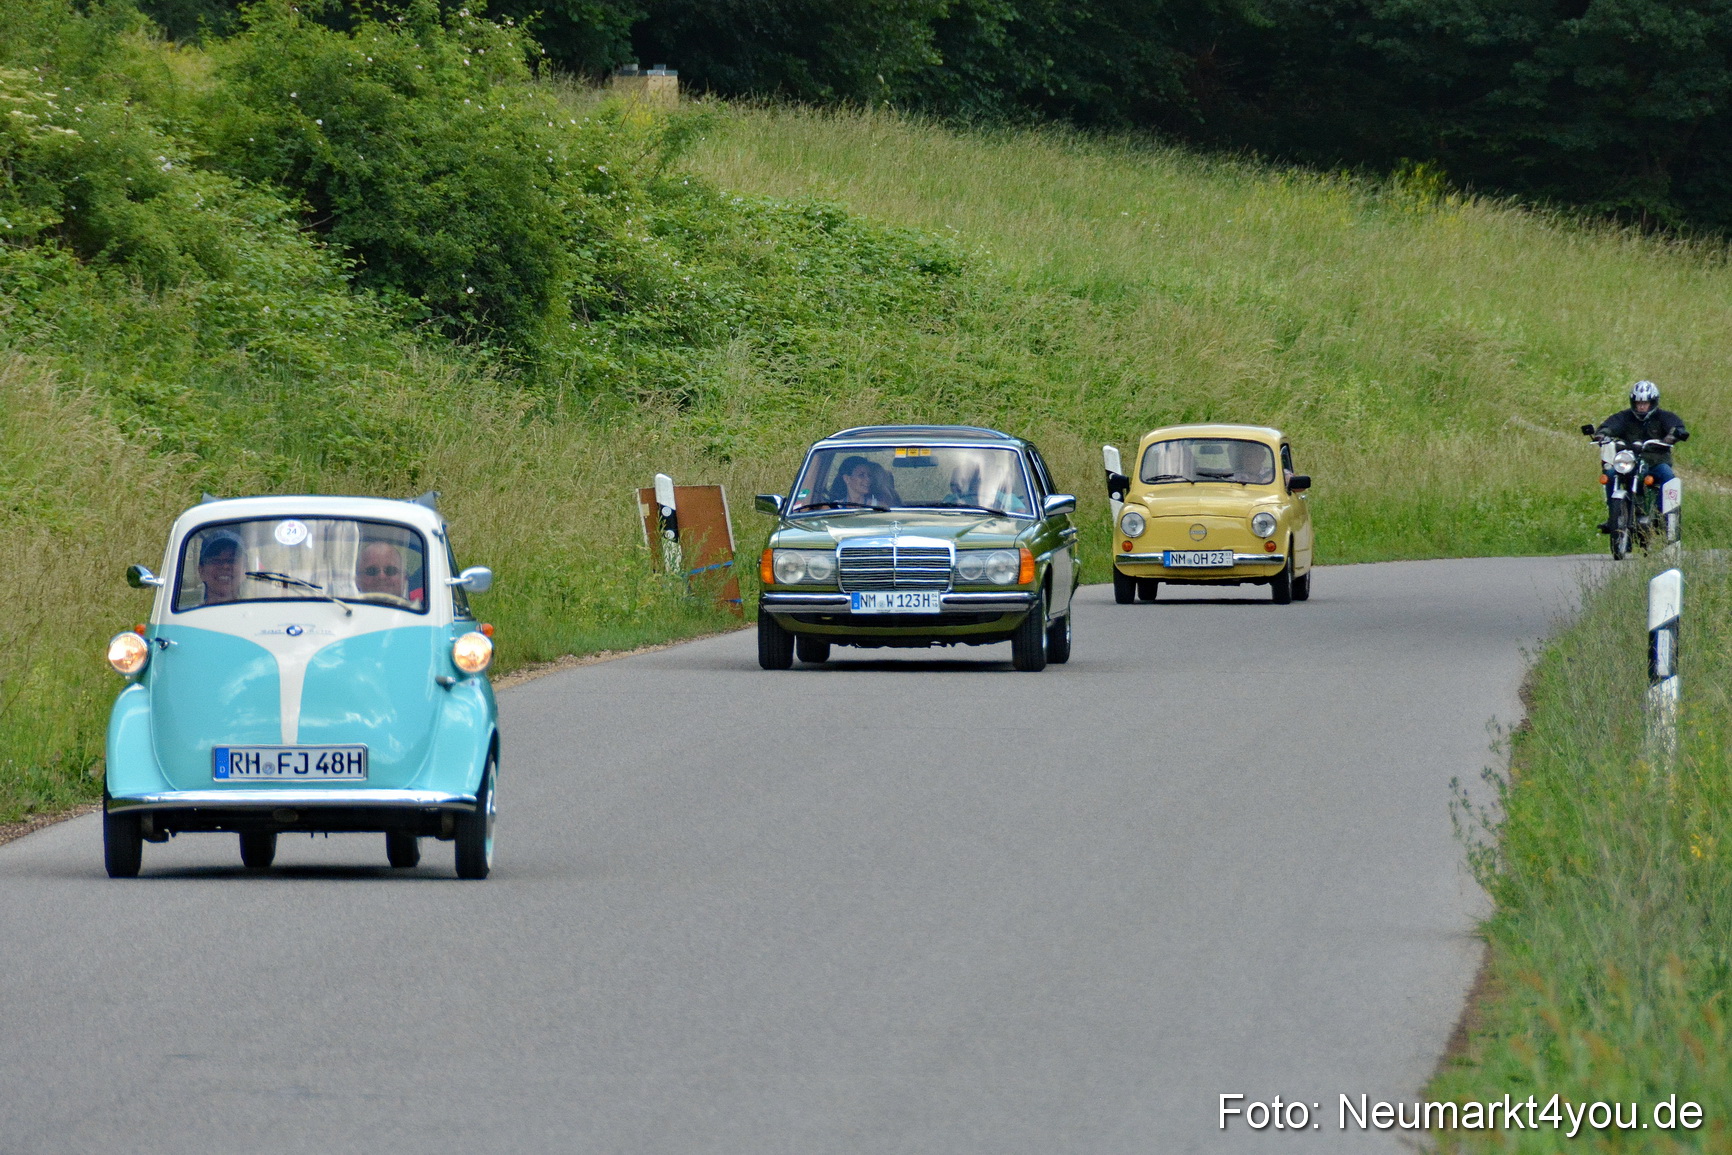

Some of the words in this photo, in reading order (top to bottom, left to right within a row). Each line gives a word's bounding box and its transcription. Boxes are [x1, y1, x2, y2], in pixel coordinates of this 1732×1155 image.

[286, 528, 297, 536] 24
[1171, 553, 1186, 564] NM
[1193, 553, 1209, 565] OH
[1210, 553, 1224, 564] 23
[860, 594, 876, 608] NM
[886, 594, 893, 608] W
[896, 593, 931, 608] 123H
[230, 752, 260, 774] RH
[277, 752, 309, 775] FJ
[315, 752, 362, 774] 48H
